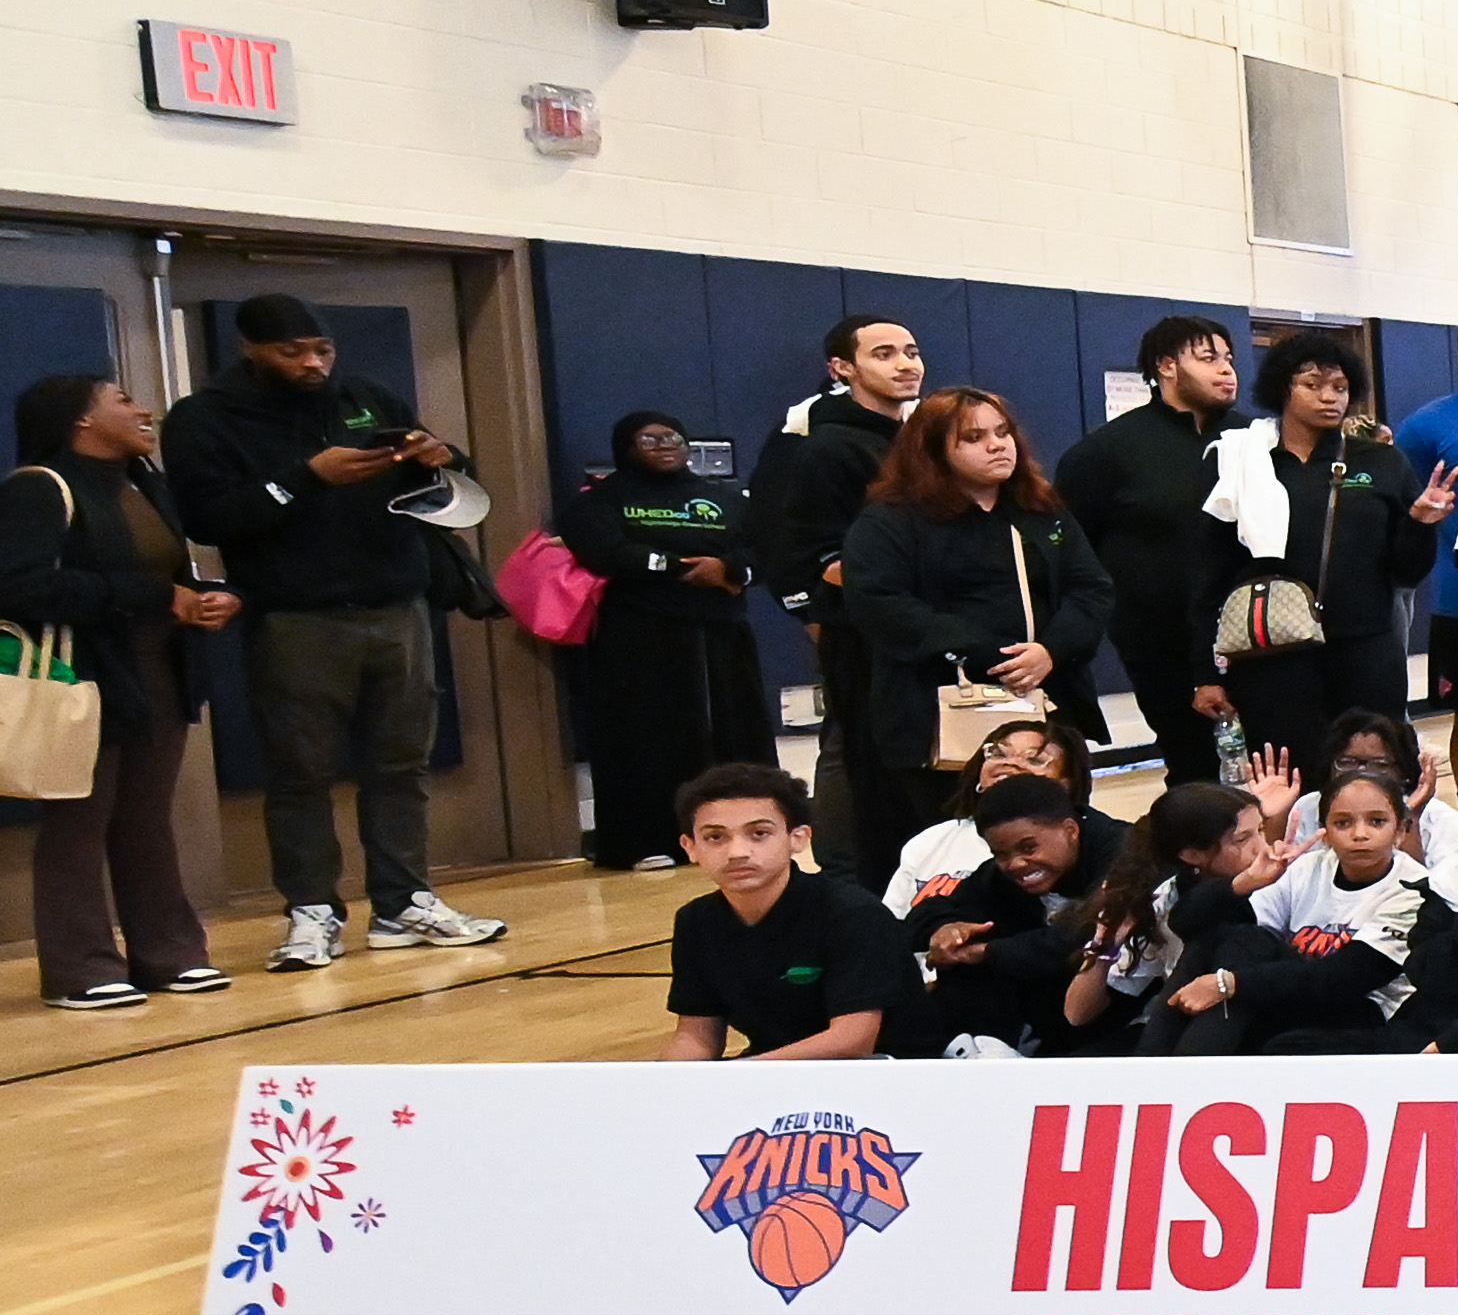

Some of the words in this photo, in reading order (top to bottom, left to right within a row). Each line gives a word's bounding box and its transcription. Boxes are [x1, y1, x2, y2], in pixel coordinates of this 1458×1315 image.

[178, 29, 277, 111] EXIT
[771, 1112, 808, 1132] NEW
[813, 1112, 855, 1132] YORK
[696, 1127, 909, 1211] KNICKS
